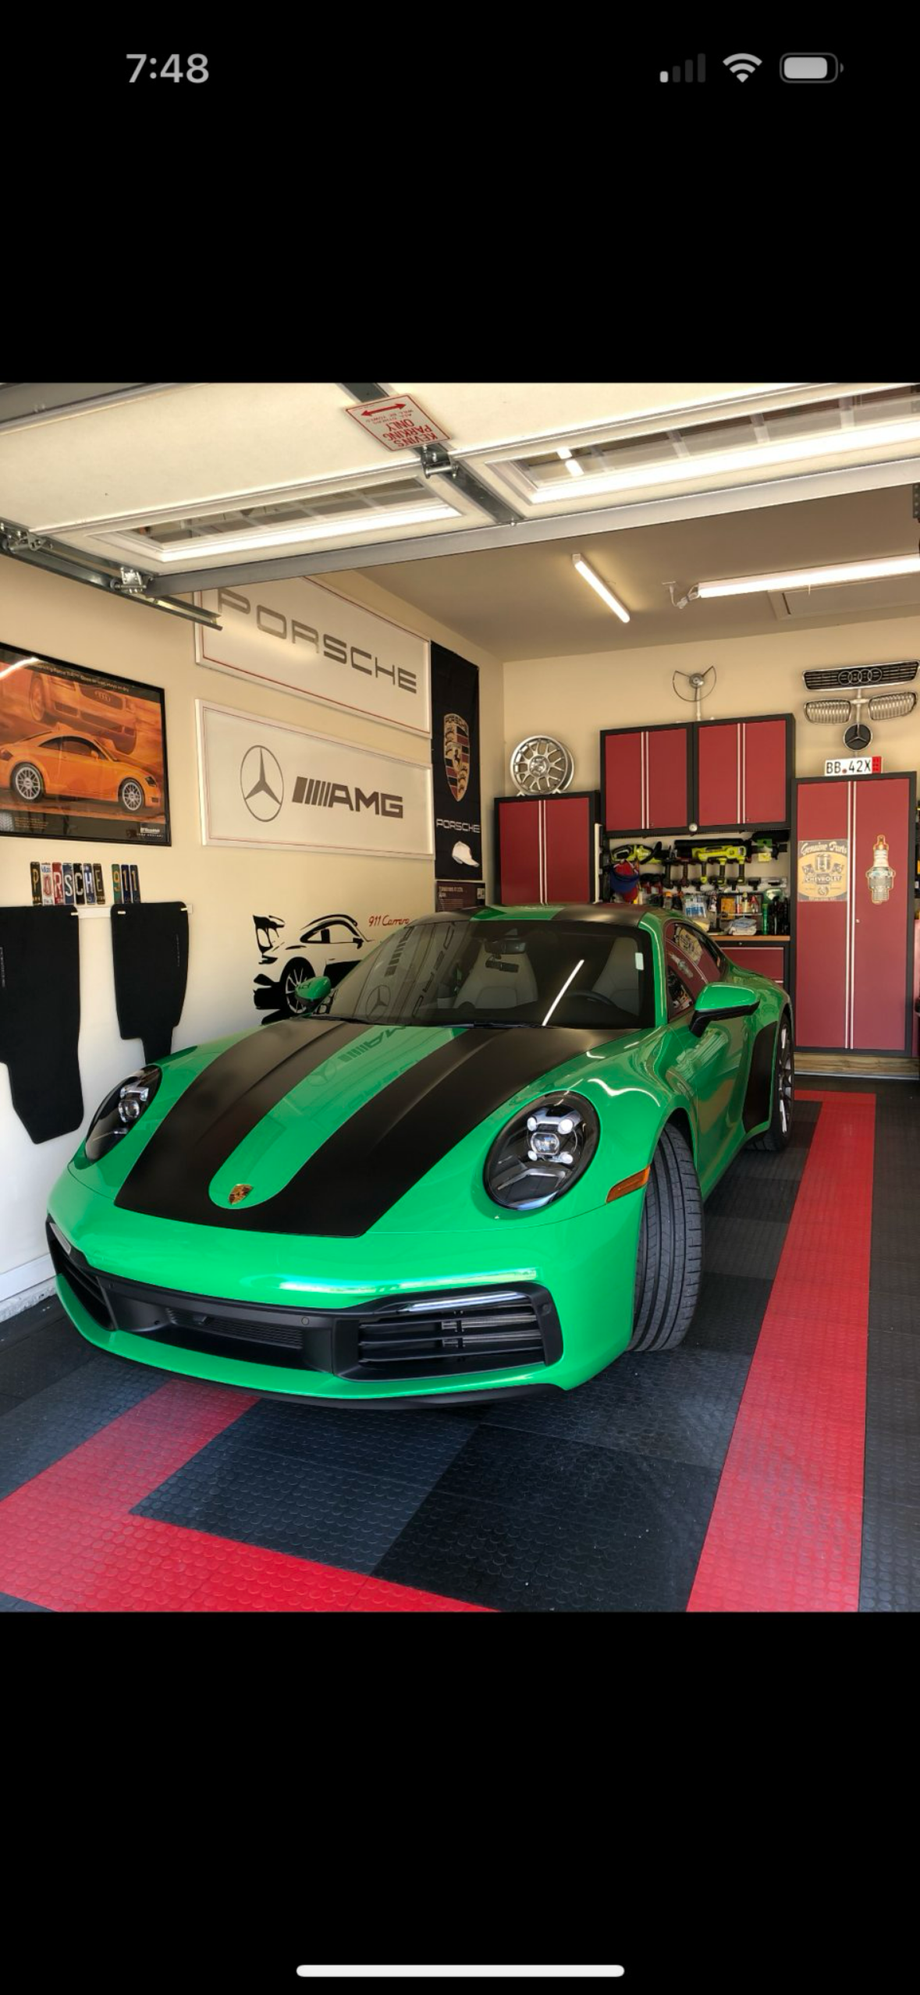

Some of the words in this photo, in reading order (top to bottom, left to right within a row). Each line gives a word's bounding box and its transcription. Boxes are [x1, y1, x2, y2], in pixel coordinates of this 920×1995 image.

[382, 424, 433, 441] PARKING
[386, 418, 415, 432] ONLY
[217, 588, 417, 694] PORSCHE
[826, 761, 841, 774] BB
[328, 782, 404, 819] AMG
[436, 818, 481, 834] PORSCHE
[32, 868, 102, 897] PORSCHE
[113, 870, 137, 892] 911
[368, 915, 381, 927] 911
[382, 914, 410, 926] Carrera
